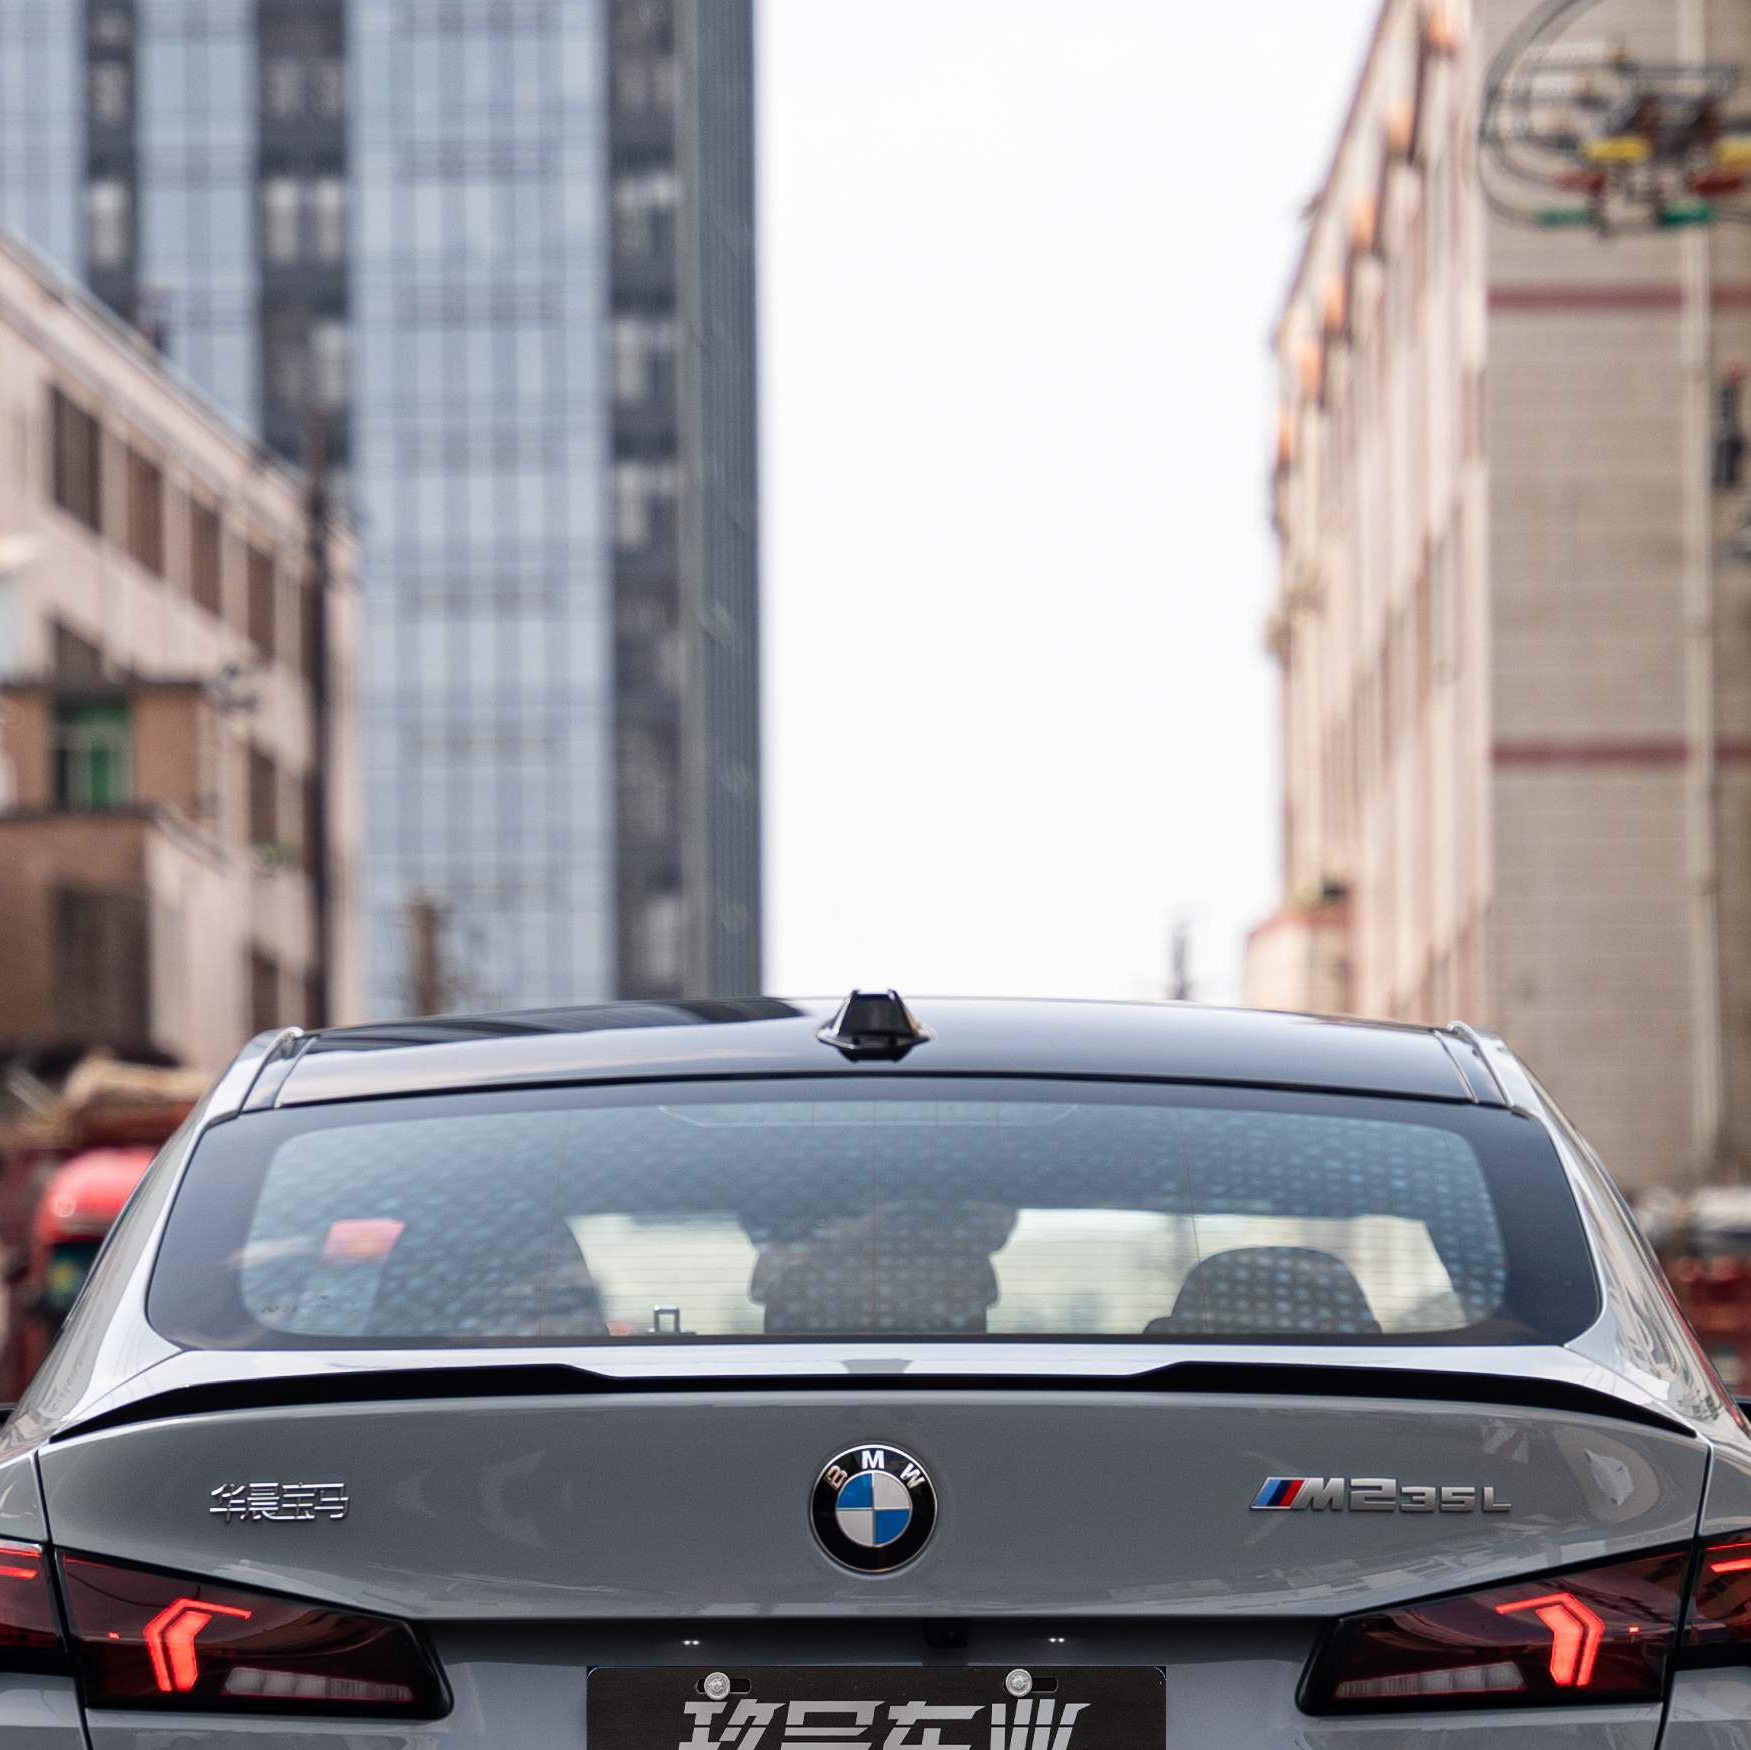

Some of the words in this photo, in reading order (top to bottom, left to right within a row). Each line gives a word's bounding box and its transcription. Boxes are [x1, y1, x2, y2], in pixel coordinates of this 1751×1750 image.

[823, 1449, 926, 1491] BMW
[208, 1482, 350, 1523] 华晨宝马
[1288, 1476, 1512, 1513] M235L
